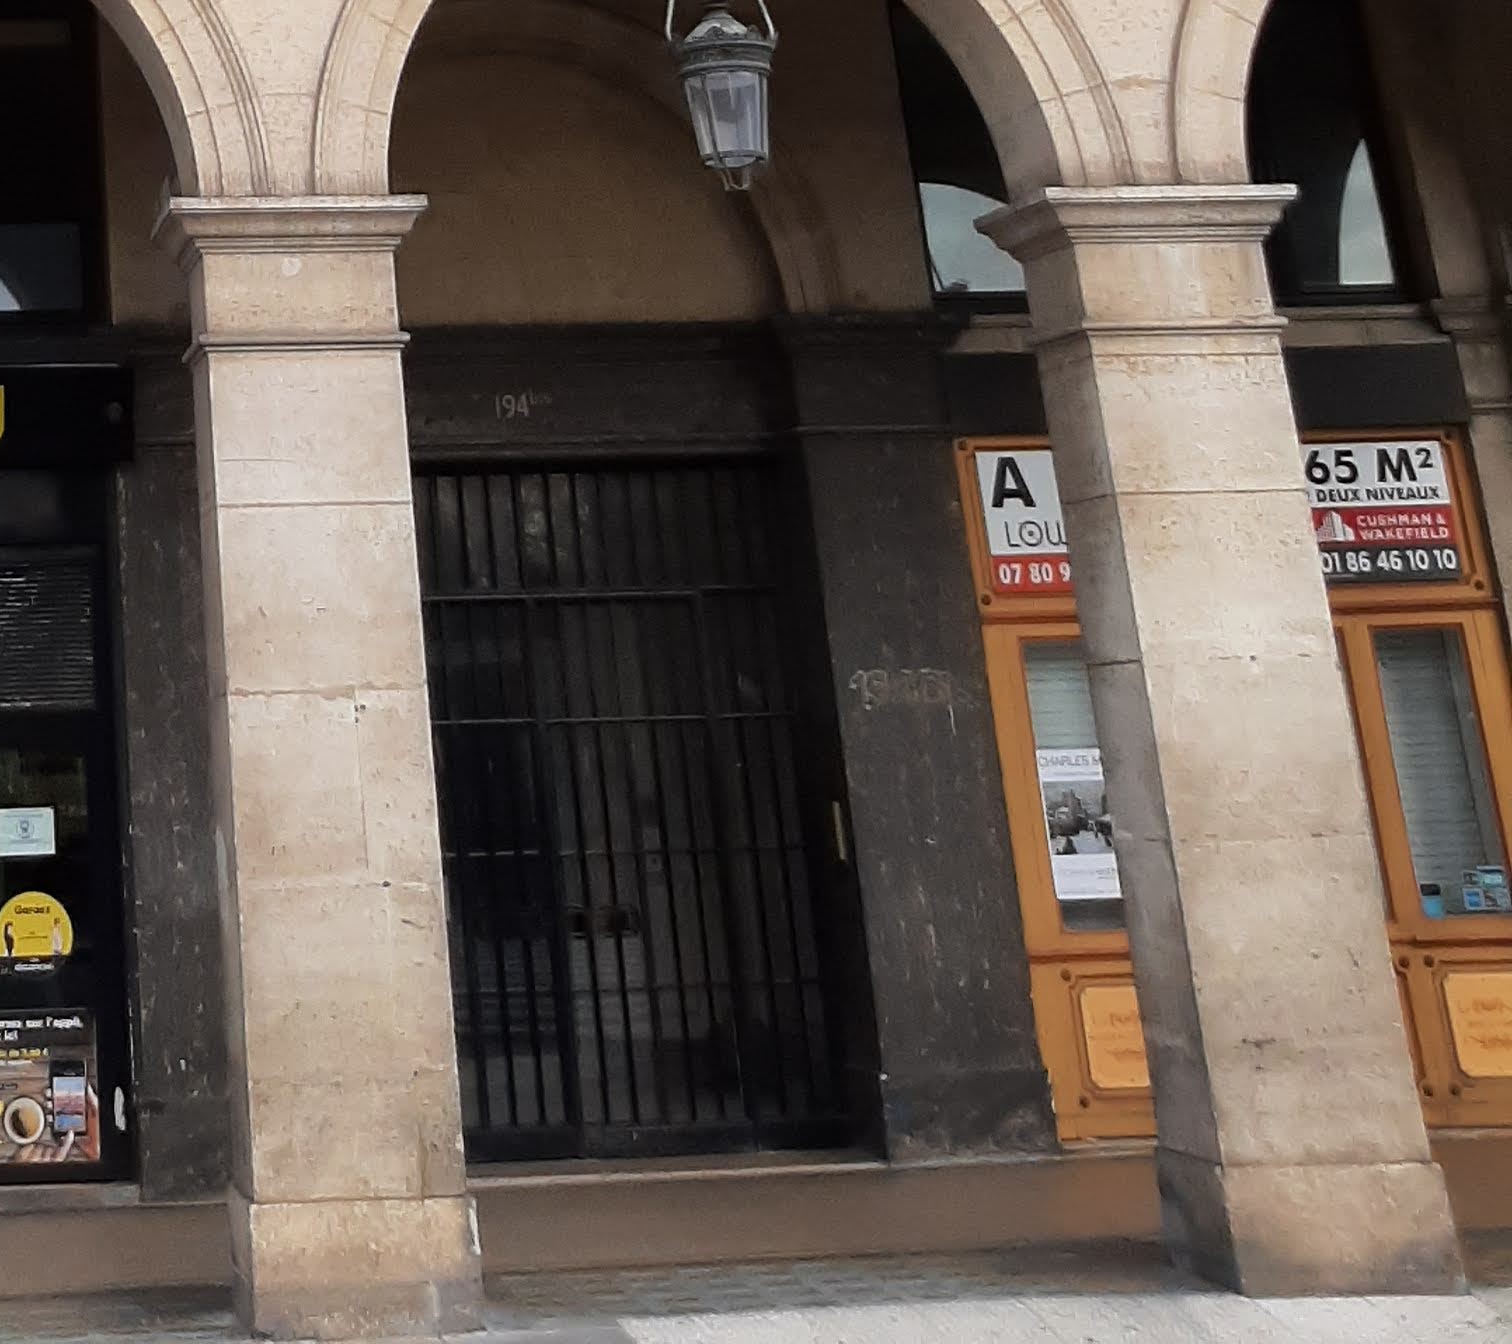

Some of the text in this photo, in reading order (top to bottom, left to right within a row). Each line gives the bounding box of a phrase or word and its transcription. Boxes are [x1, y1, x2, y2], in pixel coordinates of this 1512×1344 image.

[1305, 449, 1358, 484] 65
[992, 457, 1036, 507] A
[1315, 486, 1440, 502] DEUX NIVEAUX
[1356, 513, 1432, 527] CUSHMAN
[1358, 527, 1448, 540] WAKEFIELD
[1320, 548, 1457, 573] 01 86 46 10 10
[999, 561, 1071, 584] 07 80 9
